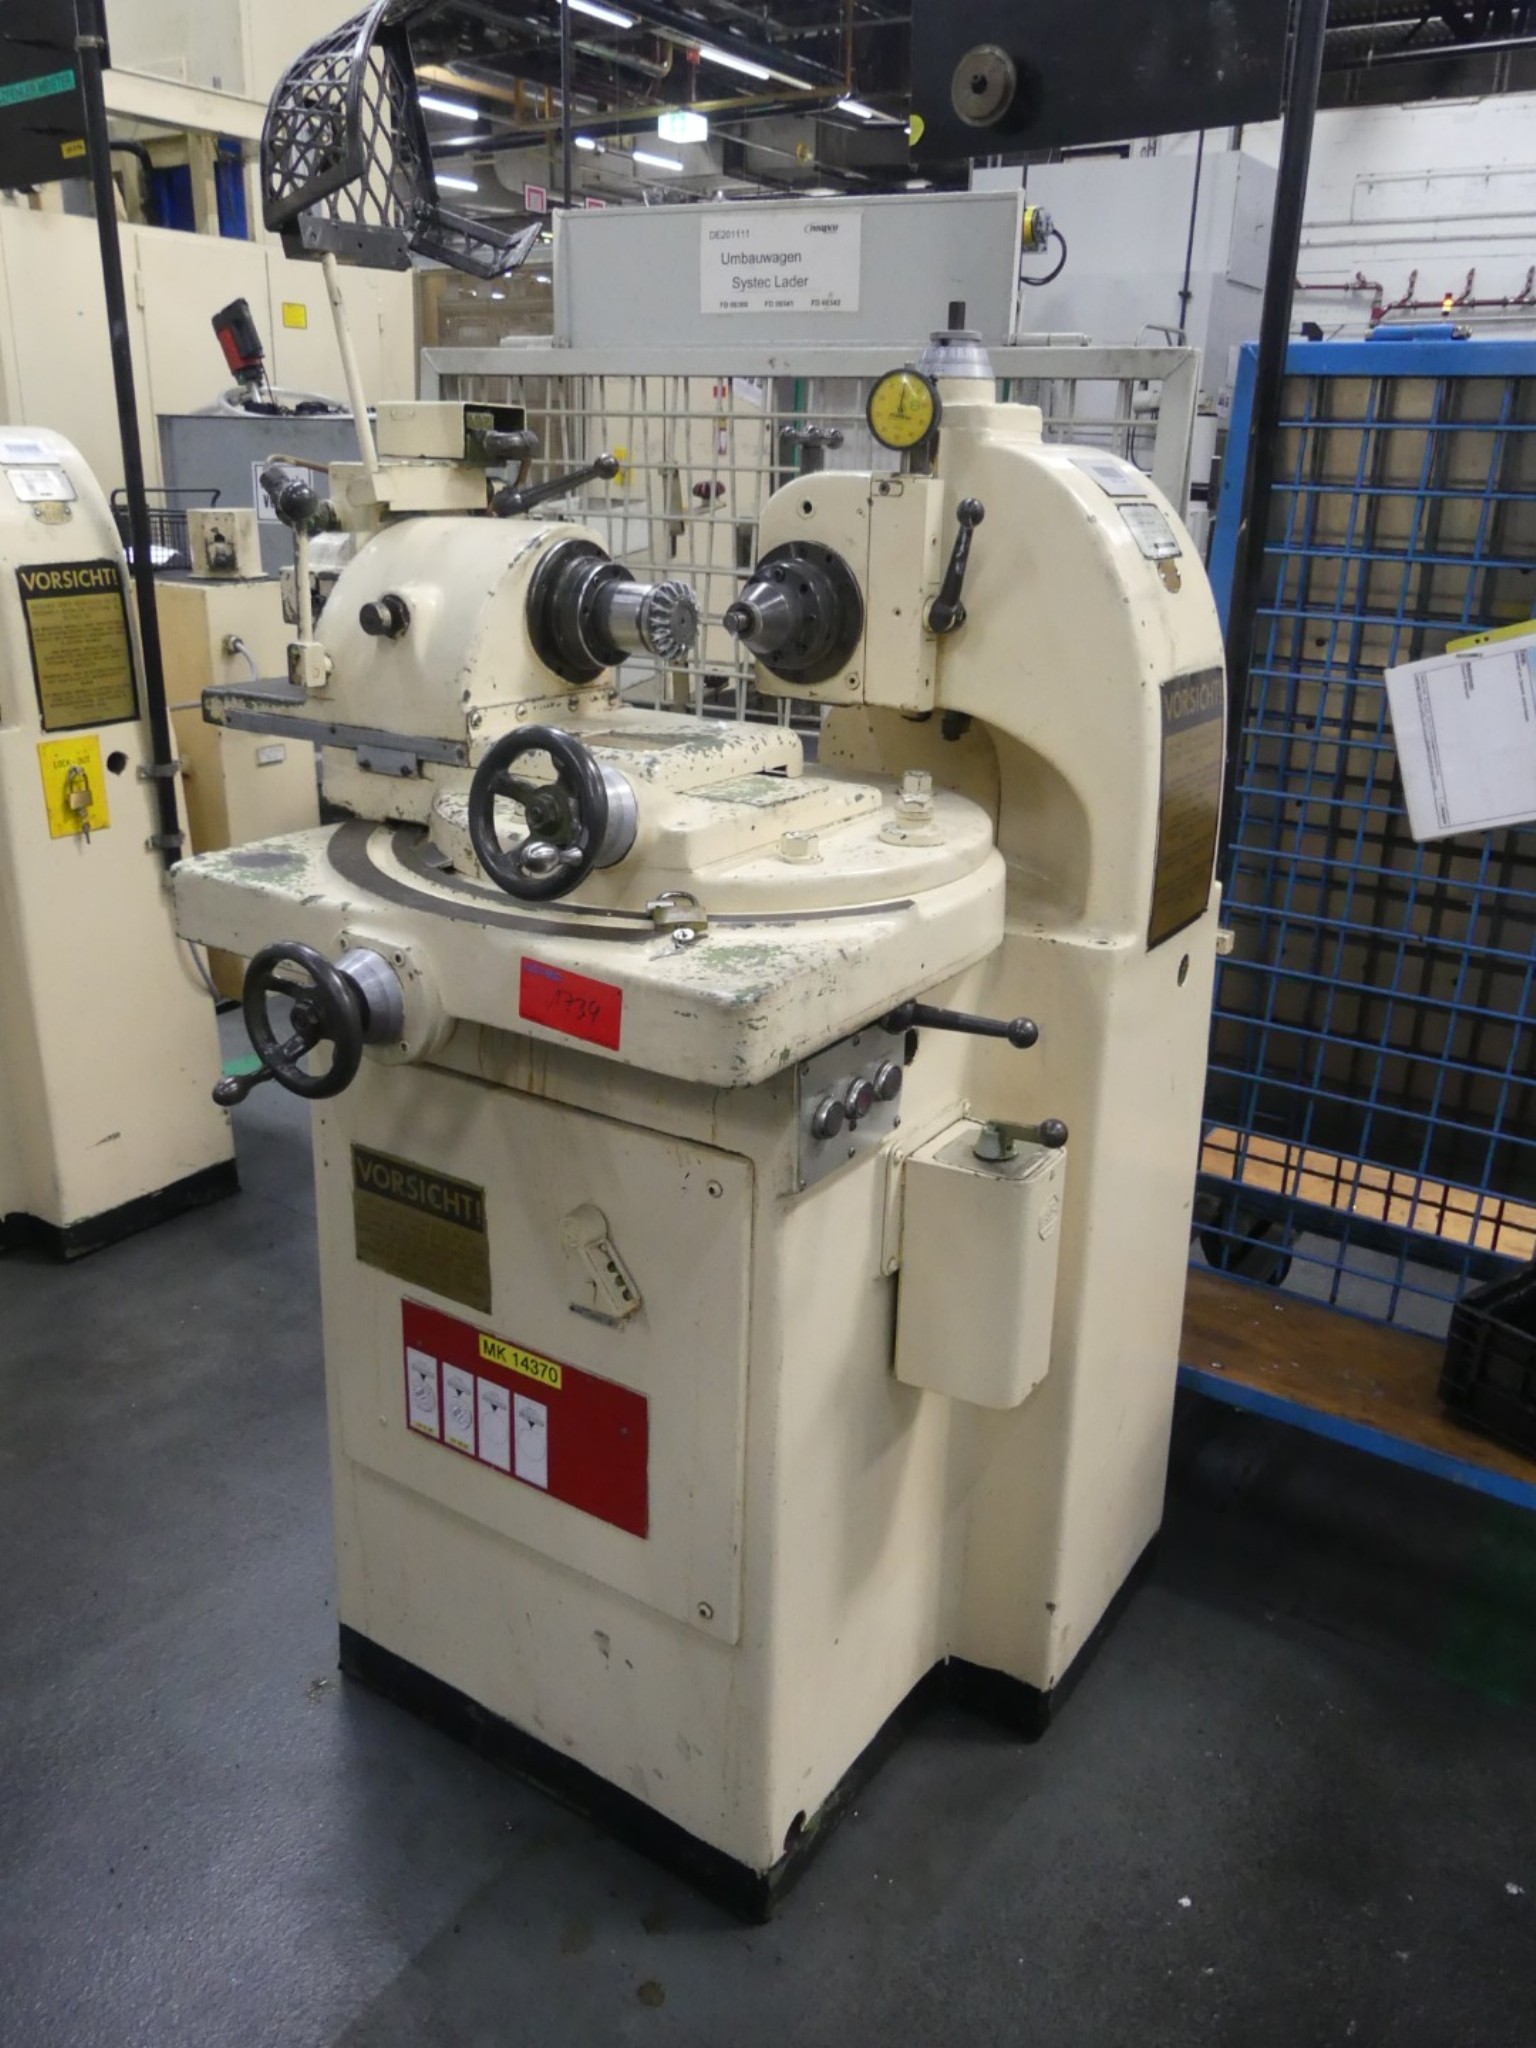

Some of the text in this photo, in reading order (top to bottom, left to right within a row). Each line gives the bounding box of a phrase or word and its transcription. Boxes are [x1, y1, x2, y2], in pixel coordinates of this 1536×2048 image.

[721, 252, 802, 266] Umbauwagen
[732, 275, 809, 292] Systec Lader
[21, 567, 118, 592] VORSICHT!
[355, 1157, 482, 1226] VORSICHT!
[483, 1339, 558, 1383] MK 14370
